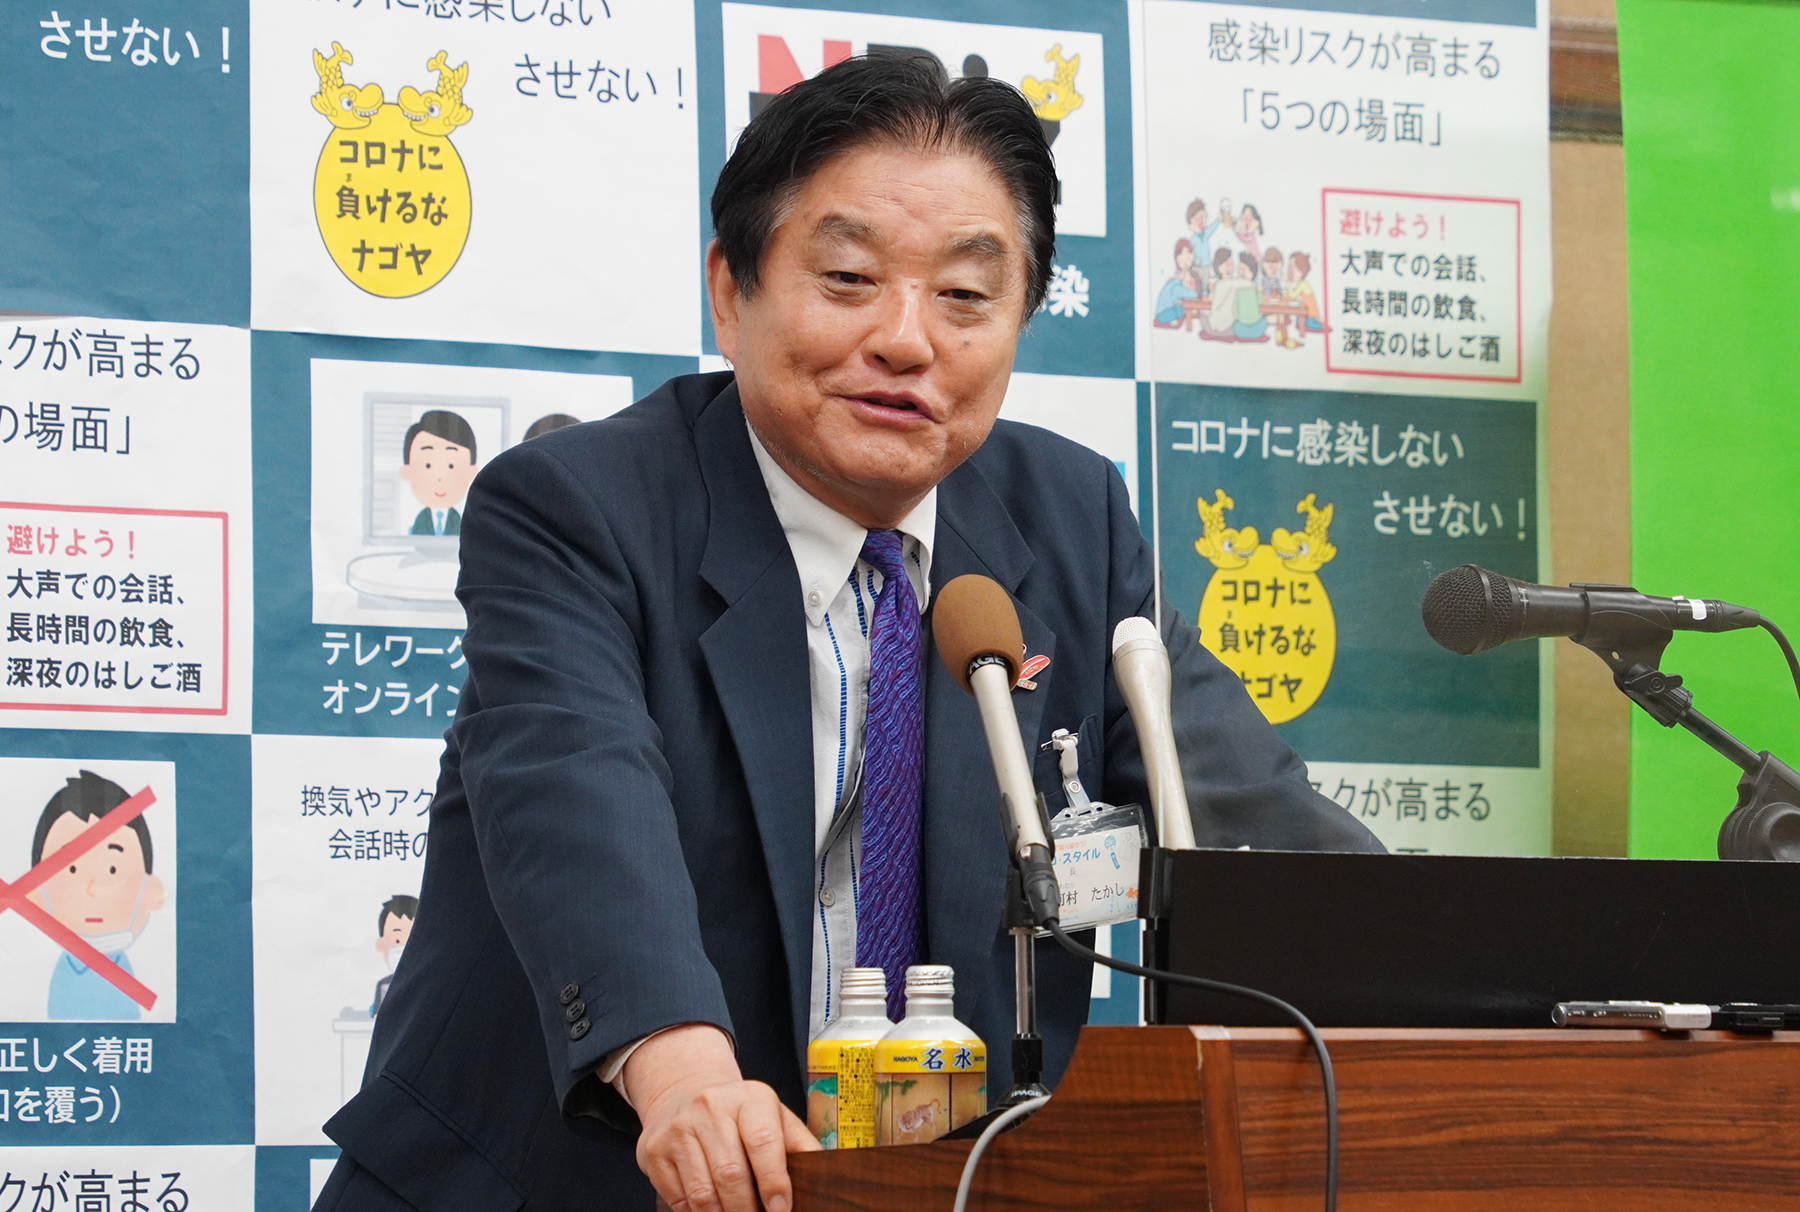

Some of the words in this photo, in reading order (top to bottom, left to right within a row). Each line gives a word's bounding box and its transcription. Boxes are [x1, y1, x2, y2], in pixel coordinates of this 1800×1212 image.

[39, 10, 230, 74] させない！
[1207, 17, 1501, 79] 感染リスクが高まる
[514, 53, 684, 109] させない！
[1243, 88, 1442, 146] 「5つの場面」
[338, 139, 444, 173] コロナに
[335, 185, 448, 226] 負けるな
[1340, 208, 1446, 241] 避けよう！
[351, 239, 433, 276] ナゴヤ
[1340, 248, 1487, 283] 大声での会話、
[1341, 287, 1487, 323] 長時間の飲食、
[0, 325, 201, 380] クが高まる
[1343, 327, 1501, 363] 深夜のはしご酒
[1171, 416, 1465, 468] コロナに感染しない
[1373, 490, 1527, 541] させない！
[6, 524, 135, 560] 避けよう！
[6, 567, 185, 605] 大声での会話、
[1221, 577, 1312, 608] コロナに
[6, 612, 185, 649] 長時間の飲食、
[1219, 621, 1317, 656] 負けるな
[6, 656, 203, 694] 深夜のはしご酒
[1311, 777, 1492, 822] クが高まる
[1091, 883, 1125, 902] たかし
